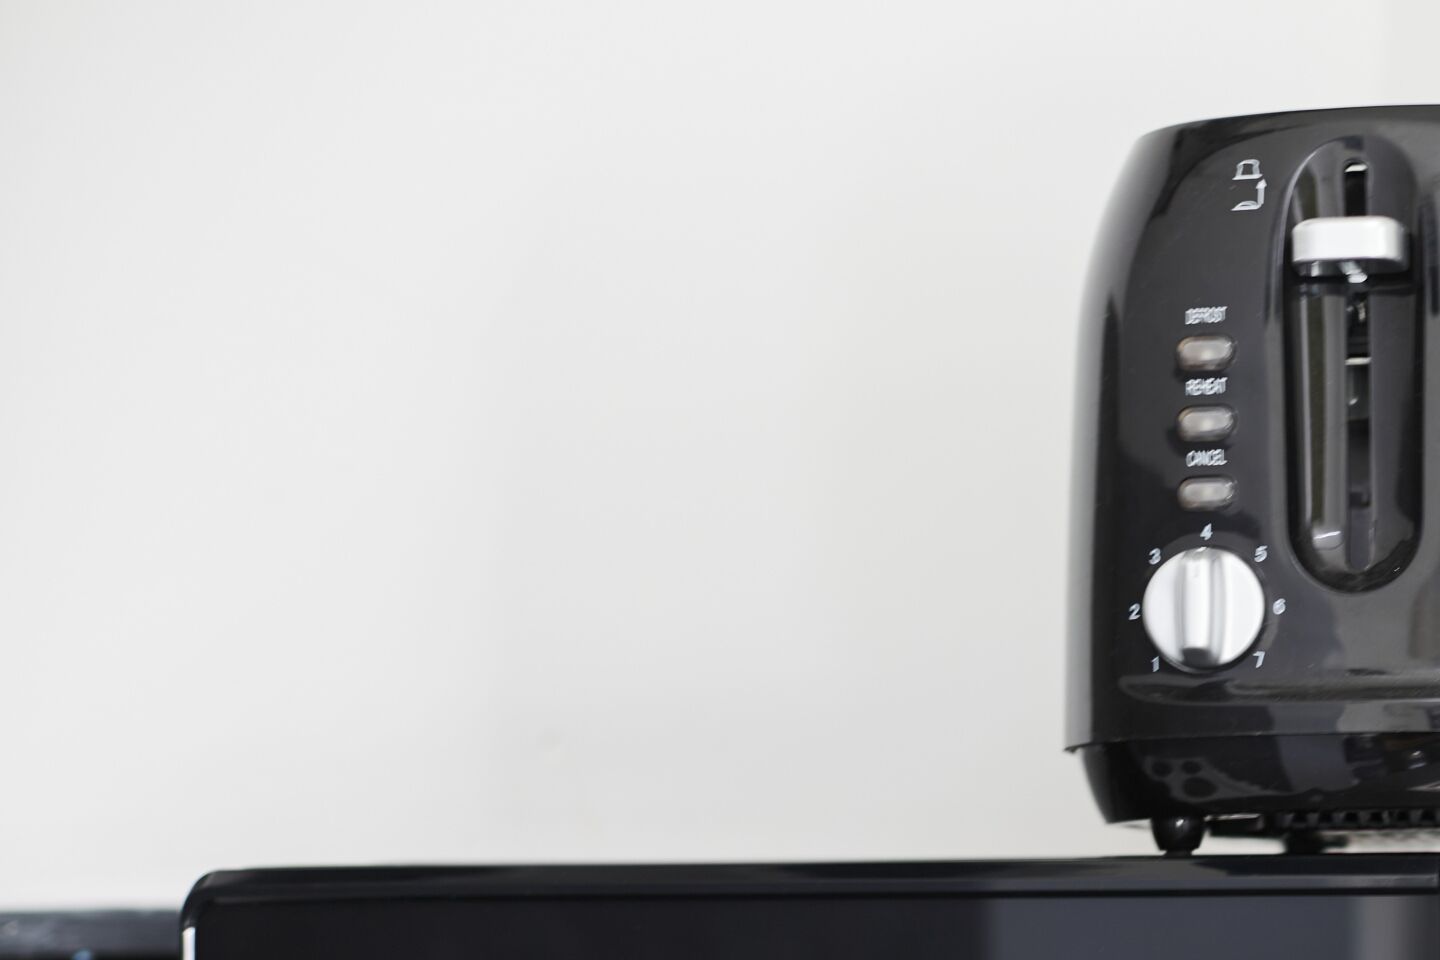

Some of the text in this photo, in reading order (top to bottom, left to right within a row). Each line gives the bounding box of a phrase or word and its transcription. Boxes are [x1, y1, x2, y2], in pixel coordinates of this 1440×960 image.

[1186, 449, 1227, 467] CANCEL
[1199, 524, 1214, 540] 4
[1149, 548, 1162, 564] 3
[1254, 546, 1268, 562] 5
[1128, 604, 1141, 620] 2
[1272, 599, 1286, 614] 6
[1151, 657, 1160, 672] 1
[1252, 651, 1266, 668] 7
